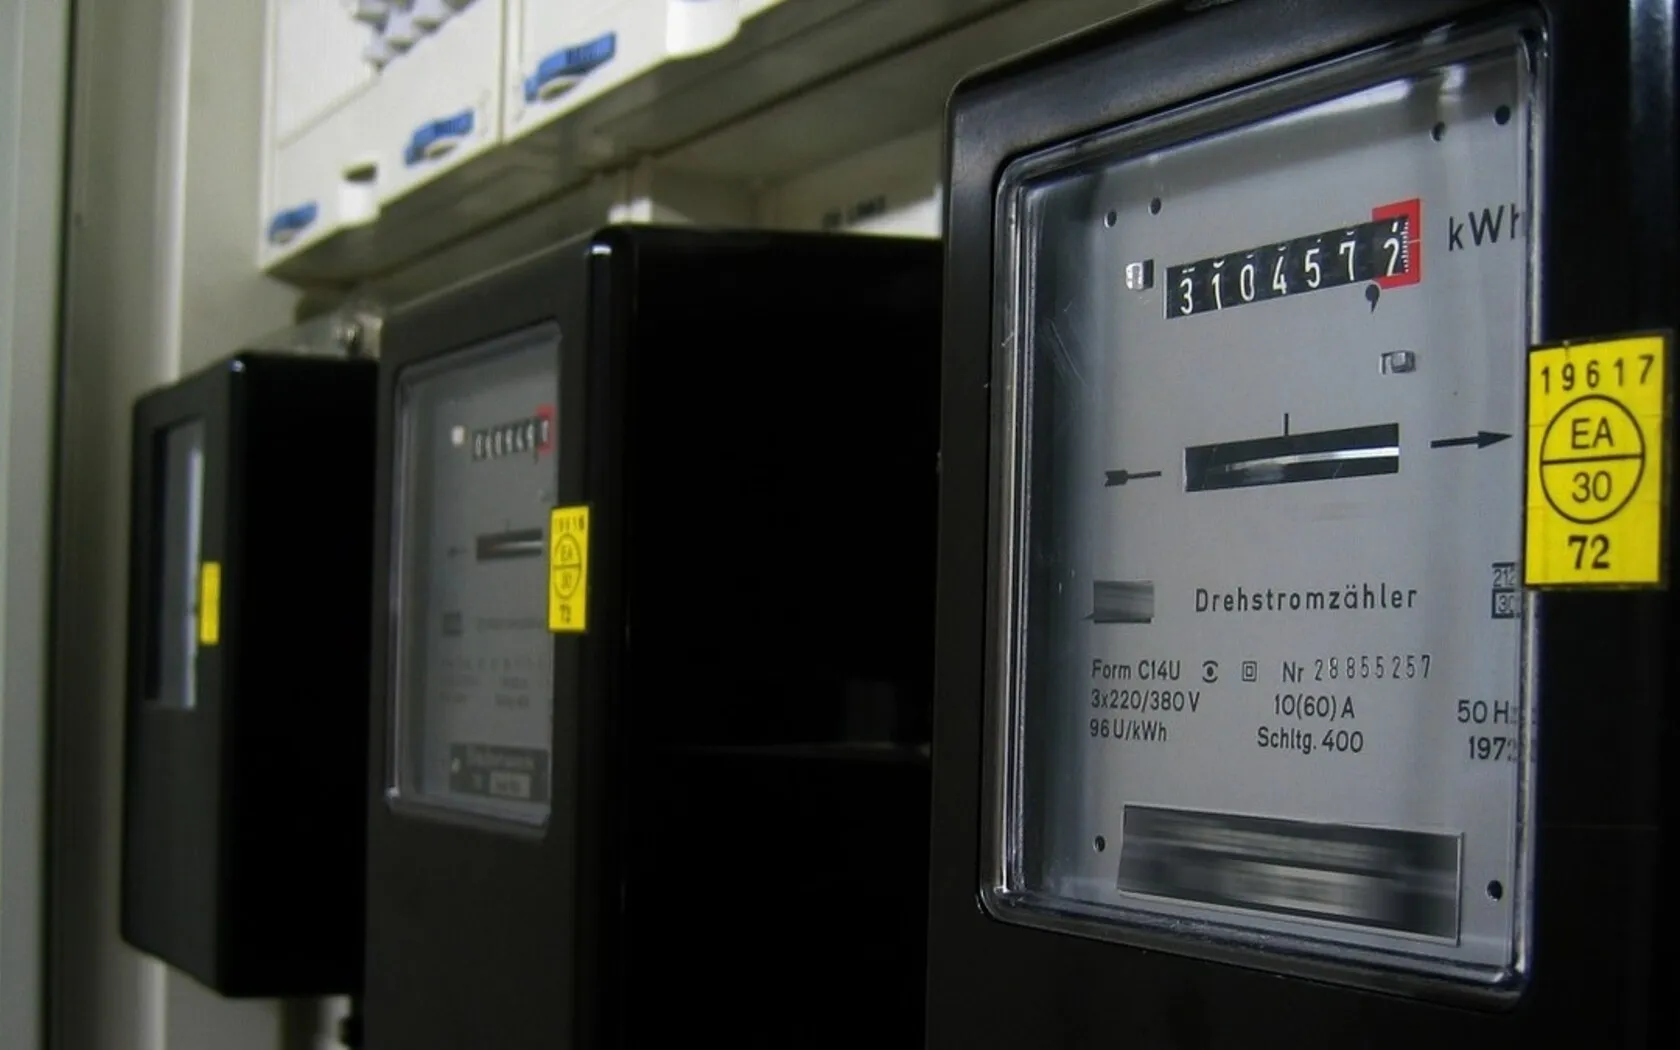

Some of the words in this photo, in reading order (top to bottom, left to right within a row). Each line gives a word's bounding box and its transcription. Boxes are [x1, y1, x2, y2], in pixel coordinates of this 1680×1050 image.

[1541, 354, 1654, 394] 19617
[1571, 417, 1615, 450] EA
[1571, 470, 1613, 503] 30
[1567, 534, 1611, 570] 72
[1195, 582, 1418, 613] Drehstromzähler
[1091, 658, 1131, 680] Form
[1138, 659, 1181, 681] C14U
[1282, 660, 1304, 683] Nr
[1315, 654, 1431, 681] 28855257
[1275, 692, 1337, 722] 10(60)
[1341, 695, 1355, 718] A
[1457, 699, 1488, 724] 50
[1257, 725, 1317, 755] Schltg.
[1322, 728, 1364, 753] 400
